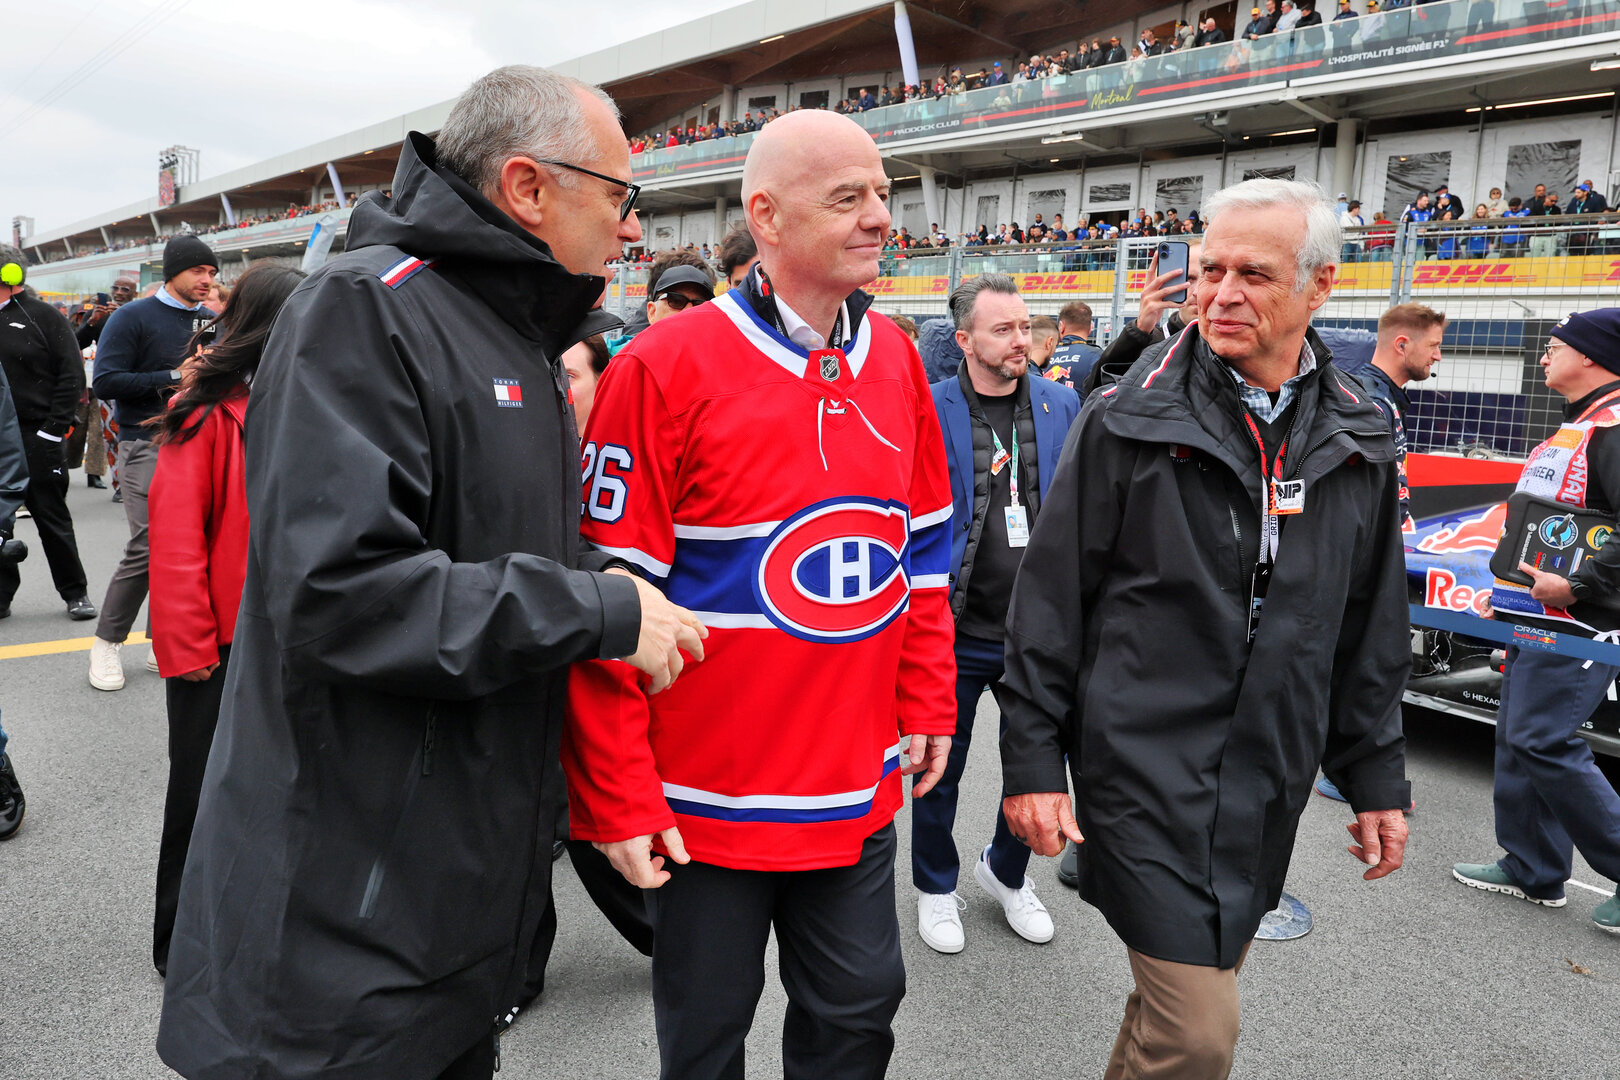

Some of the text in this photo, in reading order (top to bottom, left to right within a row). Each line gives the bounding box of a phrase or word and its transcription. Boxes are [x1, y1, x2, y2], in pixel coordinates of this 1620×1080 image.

[1395, 41, 1432, 55] SIGNÉE
[893, 123, 936, 135] PADDOCK
[936, 119, 960, 129] CLUB
[1413, 264, 1516, 284] DHL
[1022, 274, 1080, 290] DHL
[1049, 354, 1081, 365] RACLE
[580, 441, 635, 525] 26
[1514, 624, 1558, 638] ORACLE
[1472, 693, 1500, 705] HEXAG
